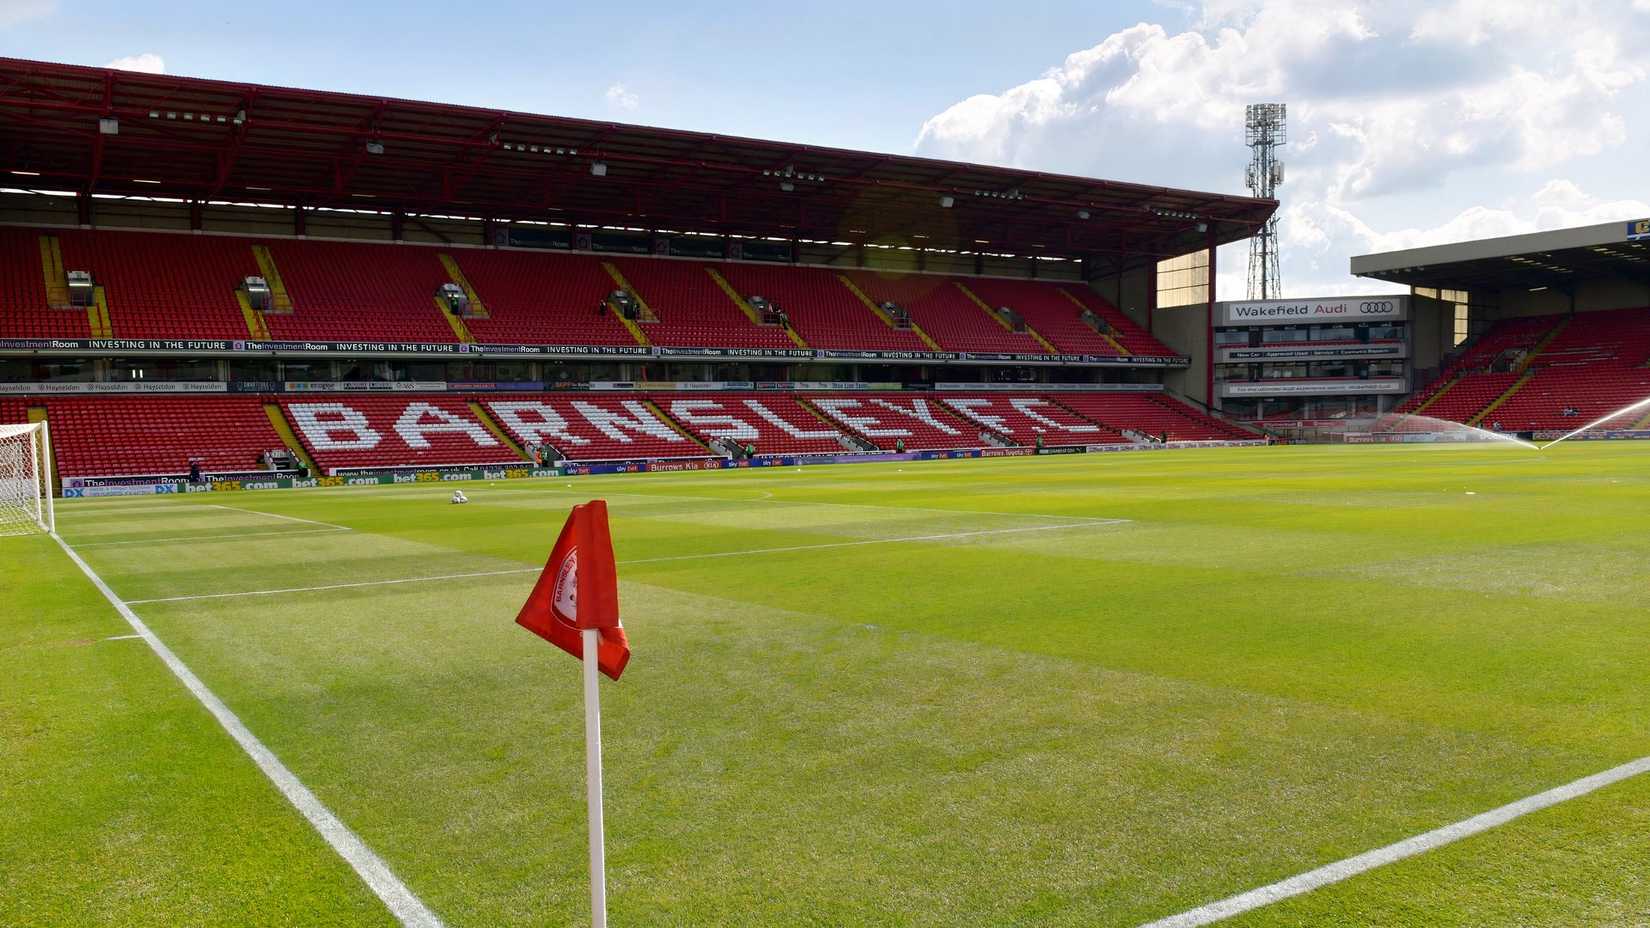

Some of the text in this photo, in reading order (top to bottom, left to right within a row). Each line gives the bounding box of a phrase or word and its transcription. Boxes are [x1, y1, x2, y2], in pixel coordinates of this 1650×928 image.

[1236, 303, 1347, 317] Wakefield Audi
[89, 341, 145, 349] INVESTING
[150, 341, 161, 349] IN
[651, 463, 683, 471] Burrows
[394, 471, 471, 483] bet365.com
[484, 468, 559, 480] bet365.com
[186, 480, 279, 493] bet365.com
[293, 476, 378, 488] bet365.com
[64, 488, 85, 497] DX
[155, 484, 174, 494] DX
[556, 556, 576, 602] BARNSLEY
